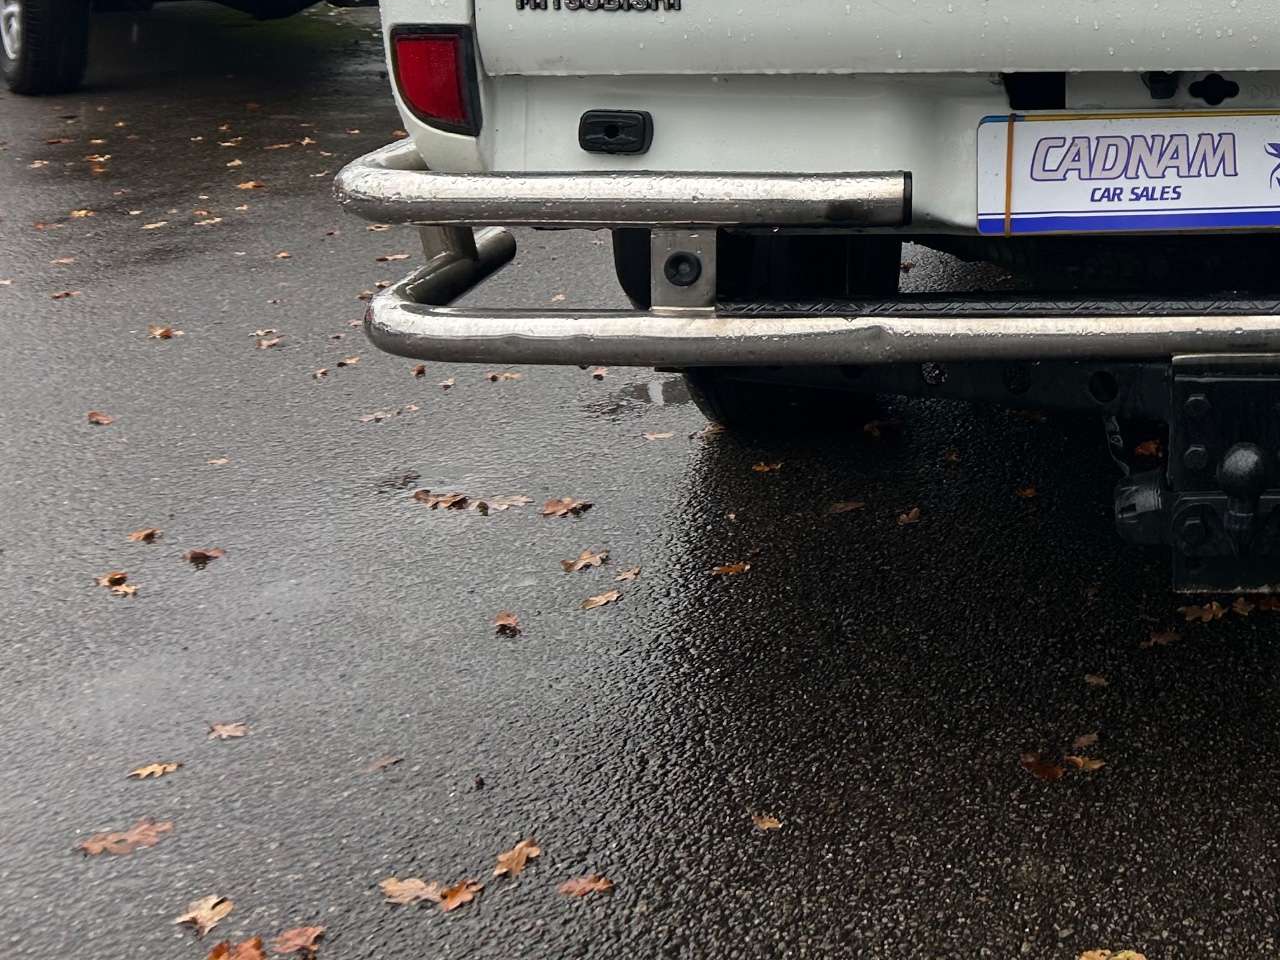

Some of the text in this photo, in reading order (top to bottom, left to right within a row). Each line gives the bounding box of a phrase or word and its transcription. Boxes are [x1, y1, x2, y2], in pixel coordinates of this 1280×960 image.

[1030, 133, 1239, 181] CADNAM
[1090, 185, 1182, 202] CAR SALES
